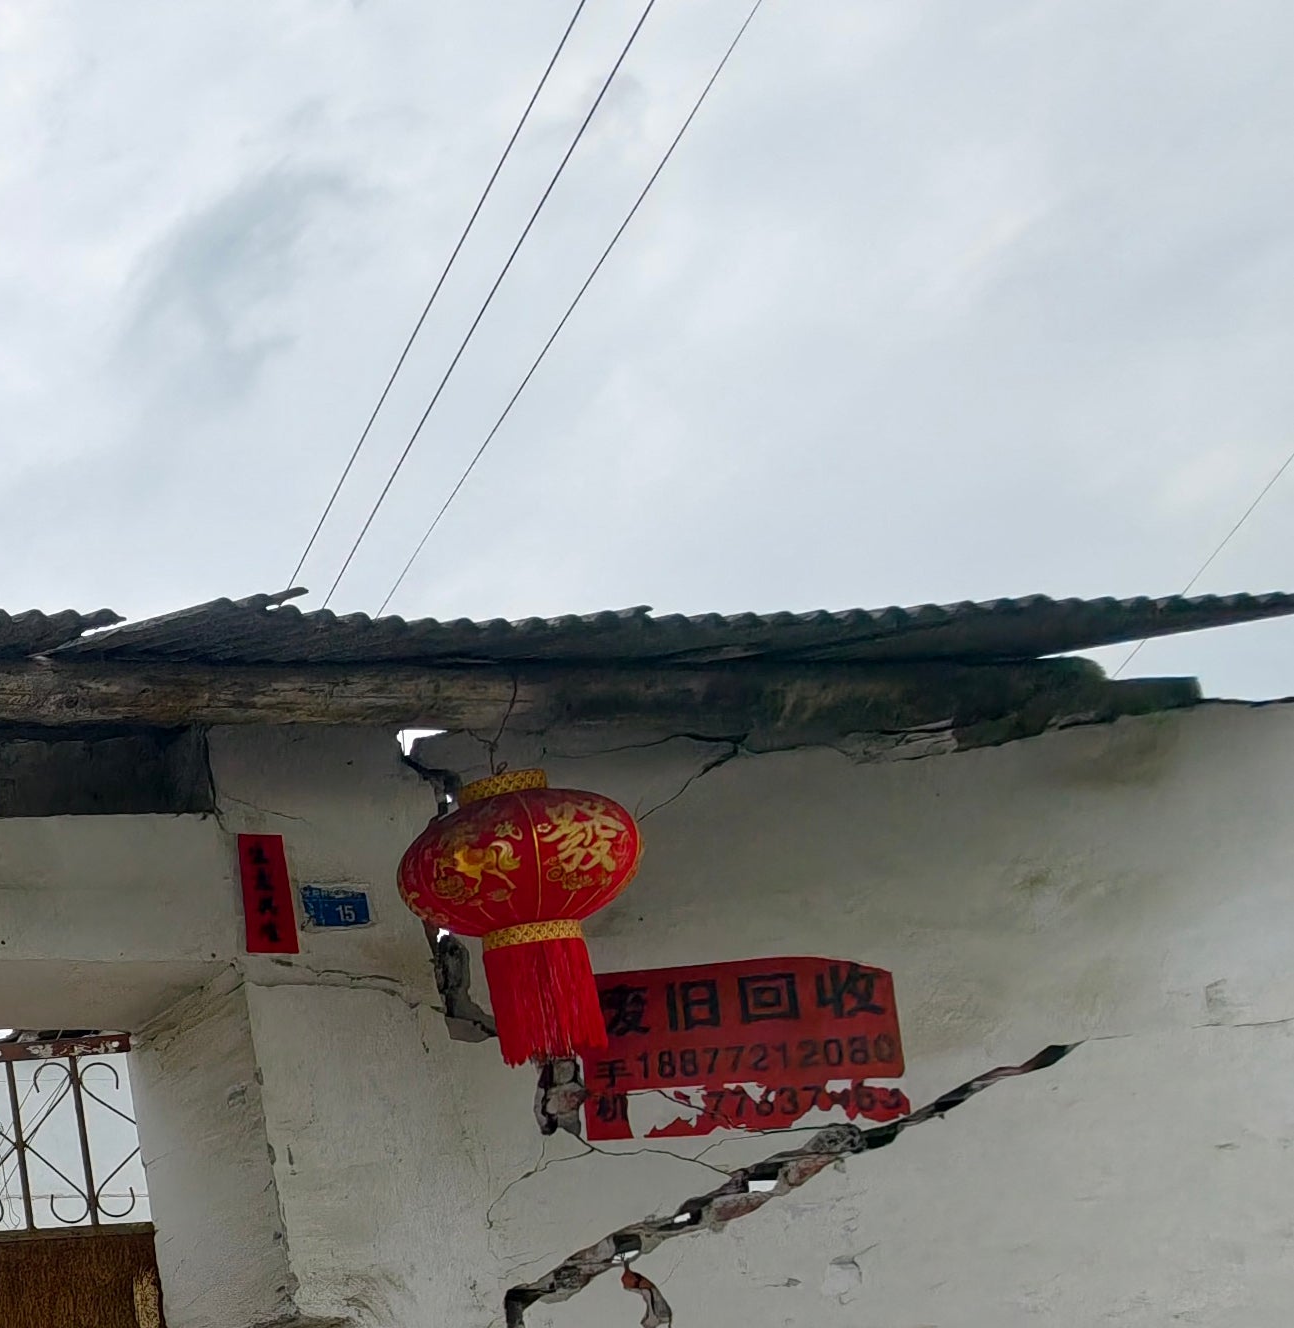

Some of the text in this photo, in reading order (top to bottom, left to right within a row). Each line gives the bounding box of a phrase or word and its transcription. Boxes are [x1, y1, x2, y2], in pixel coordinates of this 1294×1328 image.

[335, 904, 356, 923] 15
[600, 965, 886, 1036] 废旧回收
[638, 1032, 895, 1080] 18877212080
